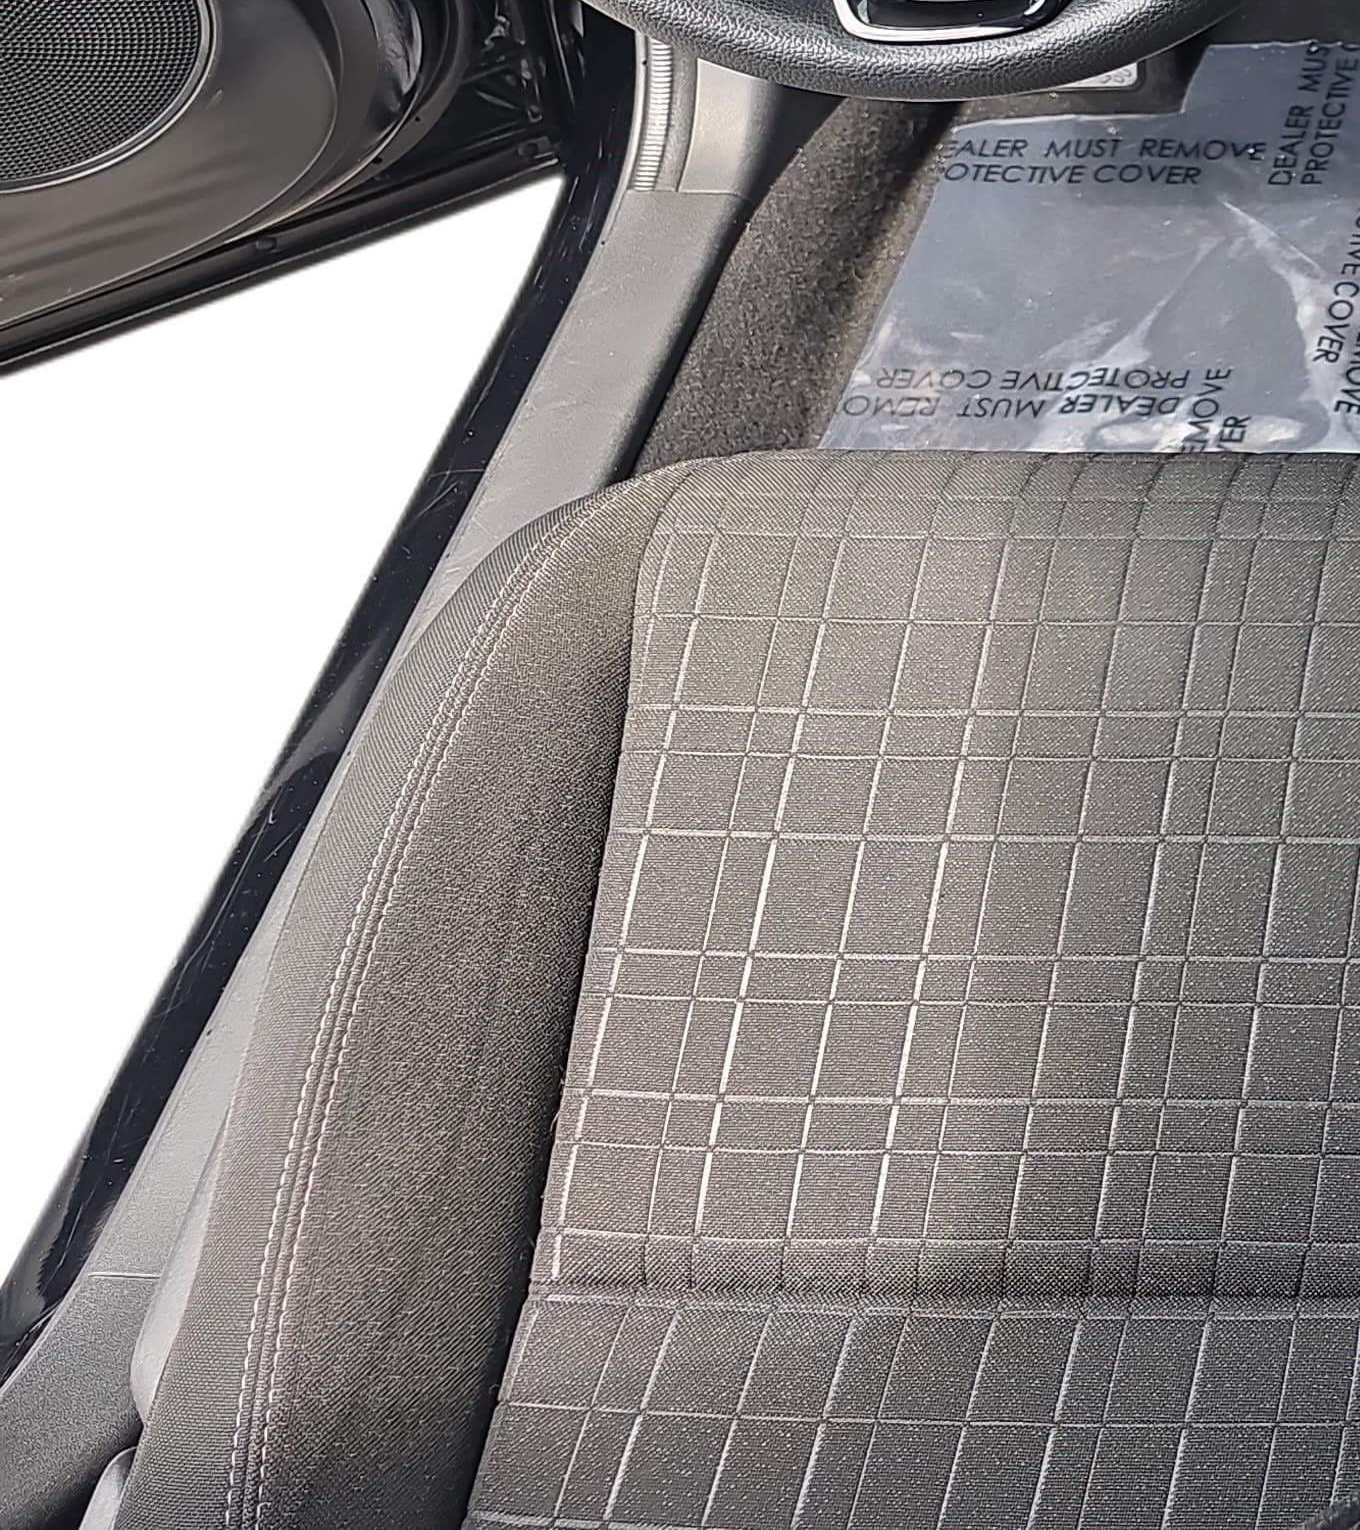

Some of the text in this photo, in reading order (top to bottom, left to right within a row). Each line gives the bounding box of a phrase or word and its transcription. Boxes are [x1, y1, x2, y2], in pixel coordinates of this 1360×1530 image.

[1267, 41, 1333, 187] DEALER MUS
[1301, 56, 1359, 188] PROTECTIVE
[943, 137, 1268, 163] EALER MUST REMOVE
[943, 164, 1203, 186] OTECTIVE COVER
[1312, 281, 1360, 366] COVER
[840, 394, 1180, 419] DEALER MUST REMO
[876, 367, 1192, 392] PROTECTIVE COVER
[1180, 367, 1233, 454] EMOVE
